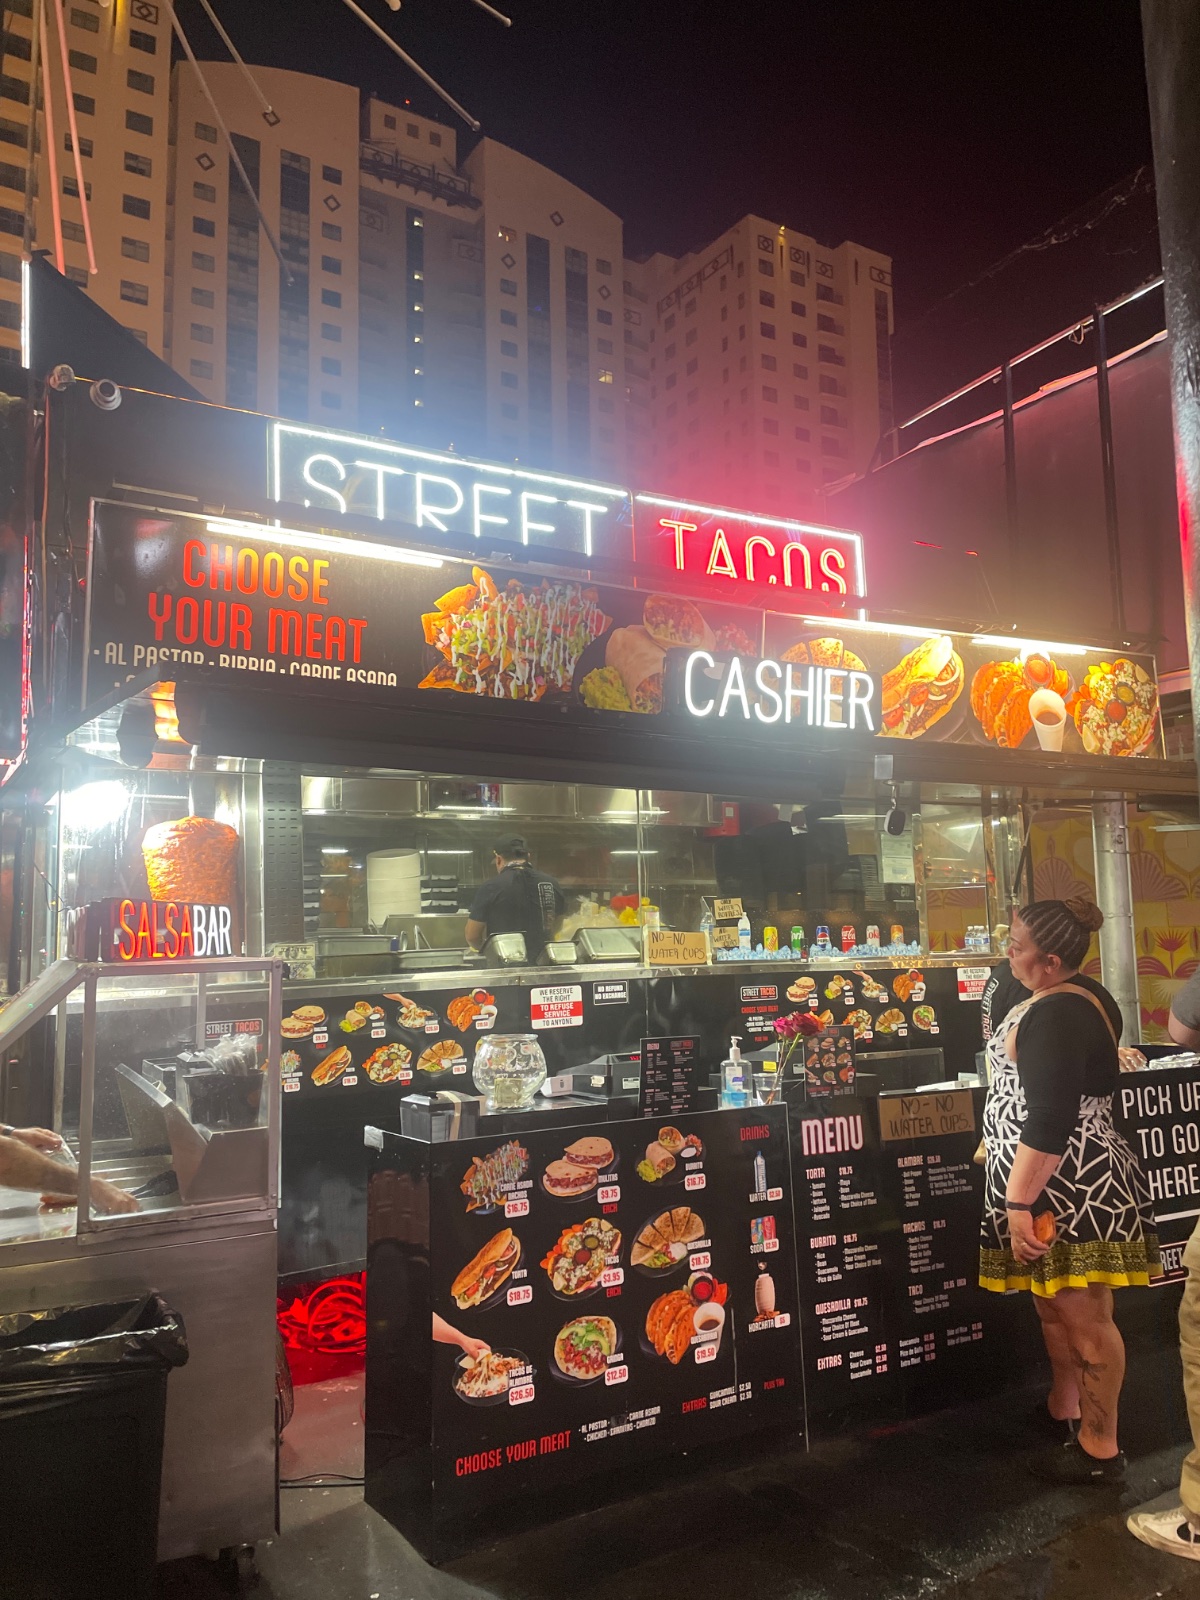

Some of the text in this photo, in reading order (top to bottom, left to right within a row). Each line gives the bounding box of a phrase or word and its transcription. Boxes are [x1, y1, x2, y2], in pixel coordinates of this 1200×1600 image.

[659, 518, 847, 595] TACOS
[183, 538, 331, 606] CHOOSE
[148, 591, 368, 665] YOUR MEAT
[105, 641, 127, 666] AL
[684, 650, 875, 732] CASHIER
[649, 948, 706, 960] WATER CUPS
[549, 987, 574, 995] RESERVE
[743, 986, 776, 996] STREET TACOS
[982, 980, 996, 1012] STREET
[550, 1002, 574, 1010] REFUSE
[544, 1010, 570, 1018] SERVICE
[206, 1021, 260, 1034] STREET TACOS
[550, 1018, 572, 1026] ANYONE
[1121, 1084, 1172, 1119] PICK
[740, 1125, 770, 1141] DRINKS
[890, 1117, 936, 1137] WATER
[802, 1114, 864, 1156] MENU
[1136, 1122, 1200, 1159] TO GO
[897, 1155, 924, 1168] ALAMBRE
[806, 1167, 826, 1180] TORTA
[686, 1176, 705, 1188] $16.75
[1148, 1164, 1200, 1200] HERE
[600, 1188, 618, 1200] $9.75
[506, 1201, 528, 1214] $16.75
[750, 1243, 764, 1254] SODA
[810, 1234, 836, 1249] BURRITO
[602, 1272, 620, 1284] $3.95
[509, 1289, 530, 1302] $18.75
[908, 1284, 923, 1296] TACO
[815, 1298, 851, 1315] QUESADILLA
[696, 1347, 715, 1360] $19.50
[817, 1354, 842, 1371] EXTRAS
[606, 1368, 626, 1382] $12.50
[510, 1387, 534, 1402] $26.50
[682, 1397, 707, 1414] EXTRAS
[456, 1430, 571, 1476] CHOOSE YOUR MEAT
